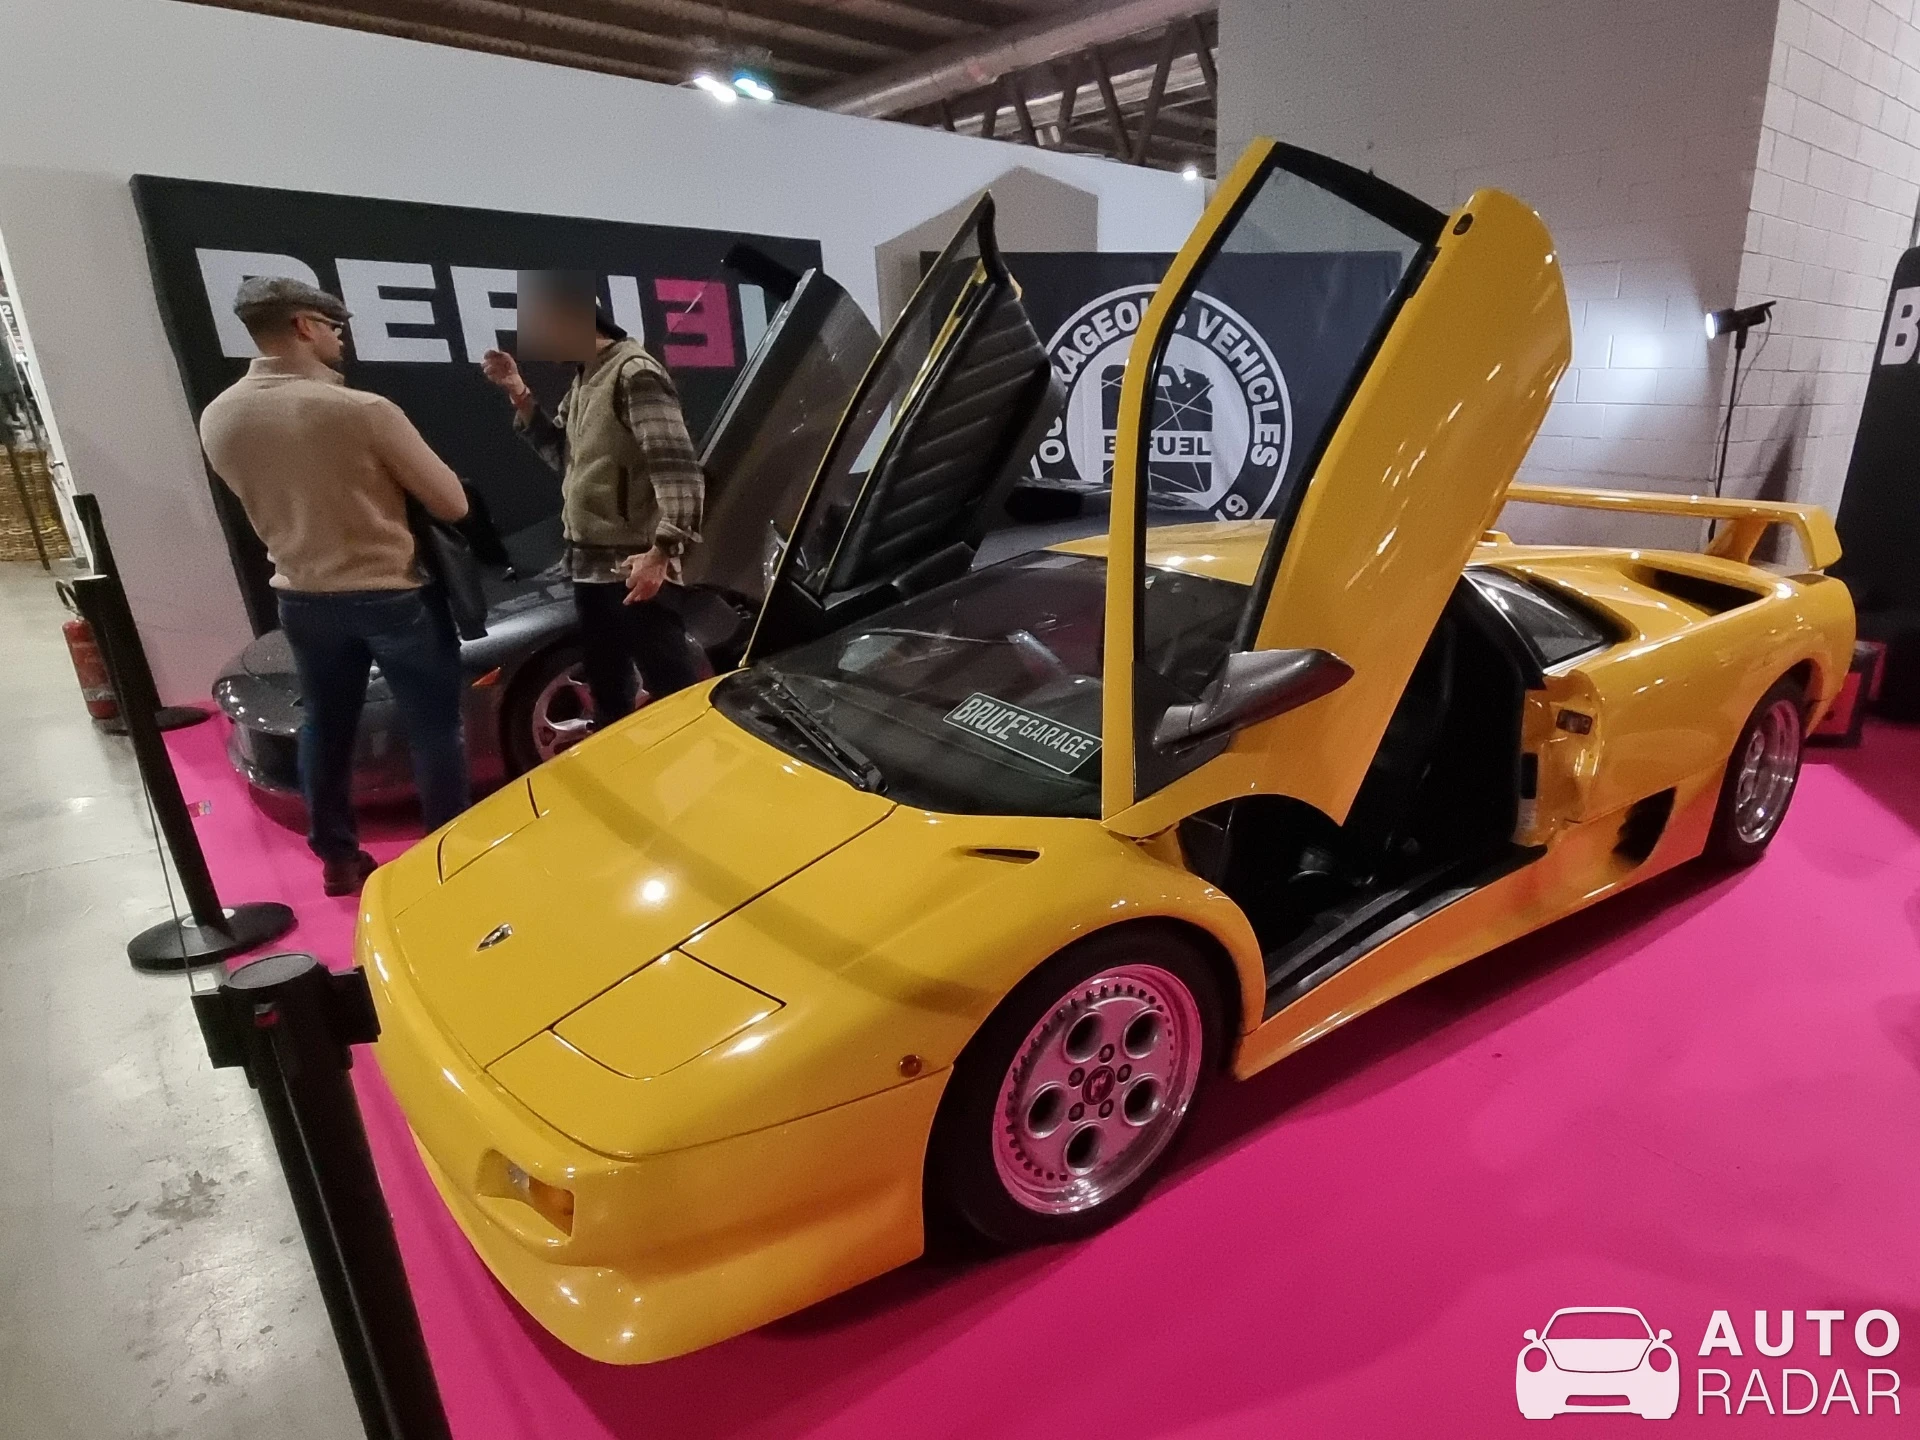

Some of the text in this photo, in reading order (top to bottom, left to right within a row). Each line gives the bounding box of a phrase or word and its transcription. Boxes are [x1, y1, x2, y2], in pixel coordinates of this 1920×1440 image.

[1197, 307, 1281, 468] VEHICLES
[952, 698, 1094, 759] BRUCE GARAGE
